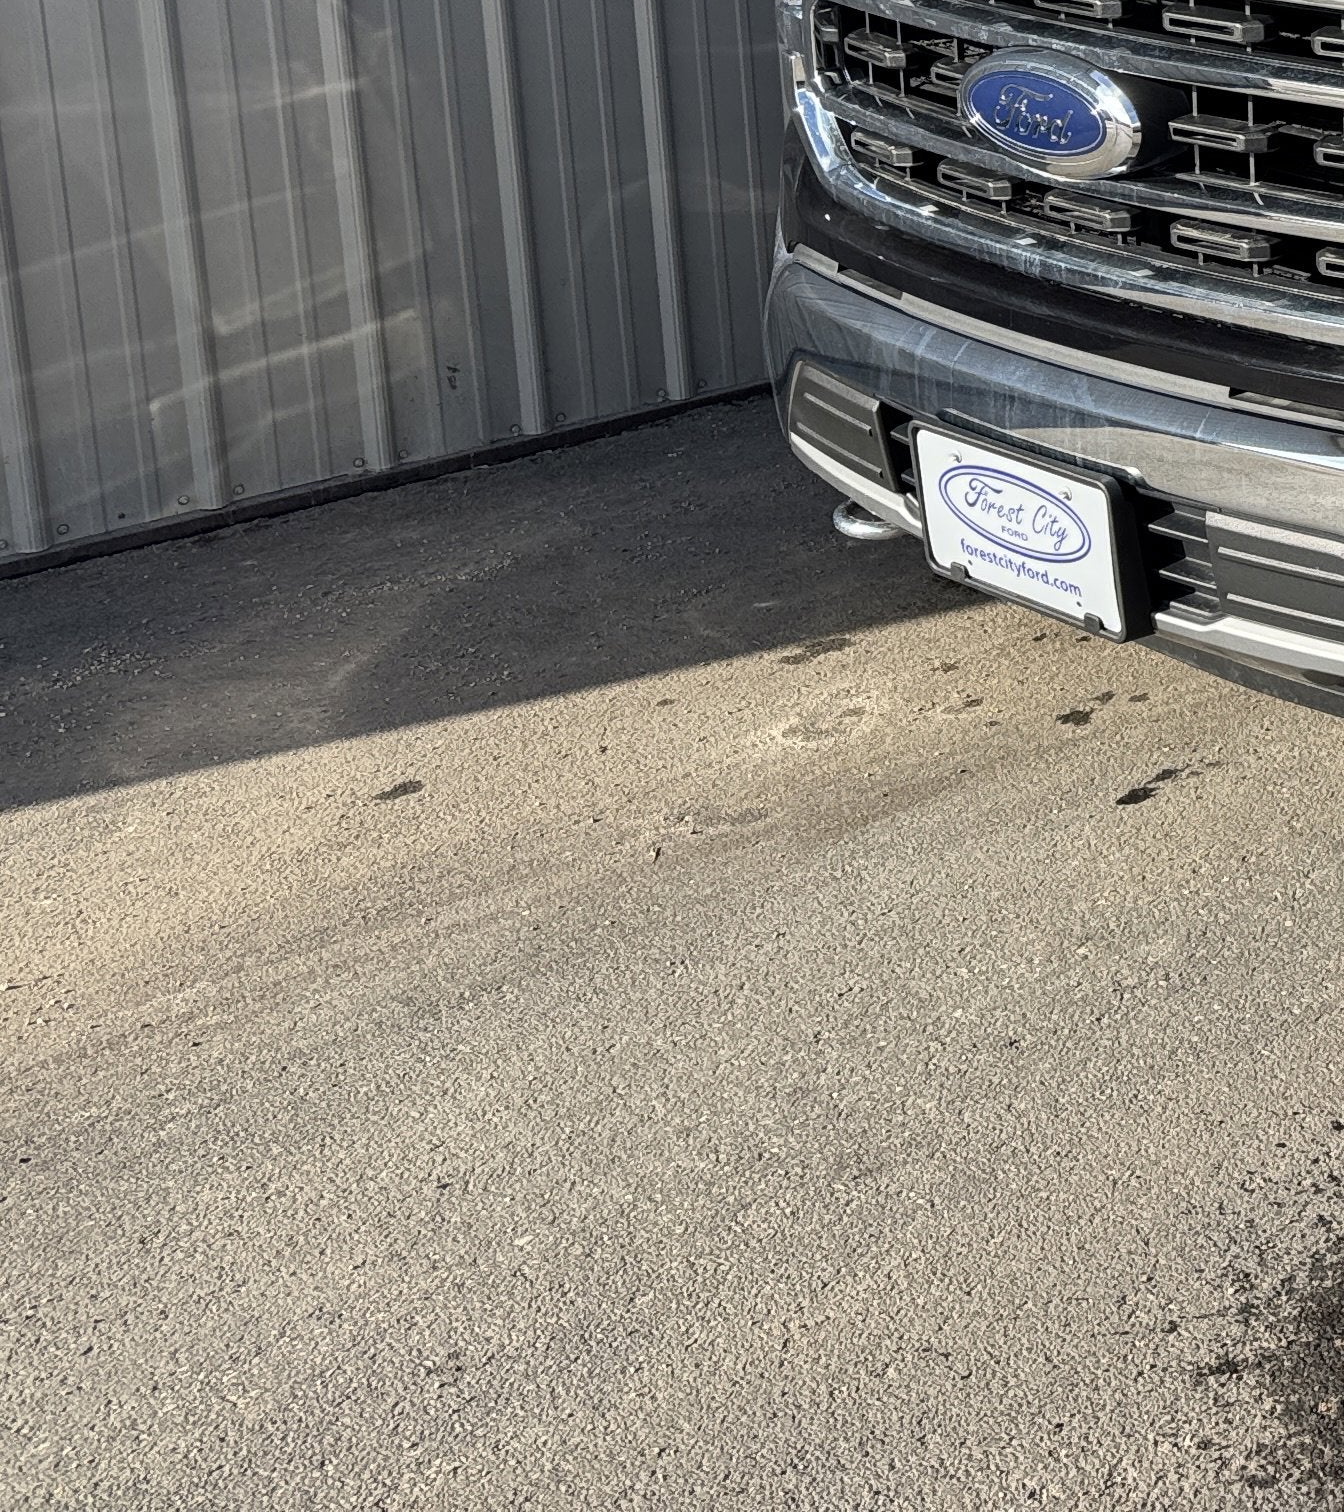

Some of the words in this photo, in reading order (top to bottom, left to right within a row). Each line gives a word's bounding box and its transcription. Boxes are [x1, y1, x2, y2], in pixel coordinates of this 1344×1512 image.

[993, 83, 1074, 145] Ford
[964, 477, 1024, 526] Forest
[1032, 504, 1068, 552] City
[1000, 525, 1029, 542] FORD
[960, 538, 1083, 598] forestcityford.com
